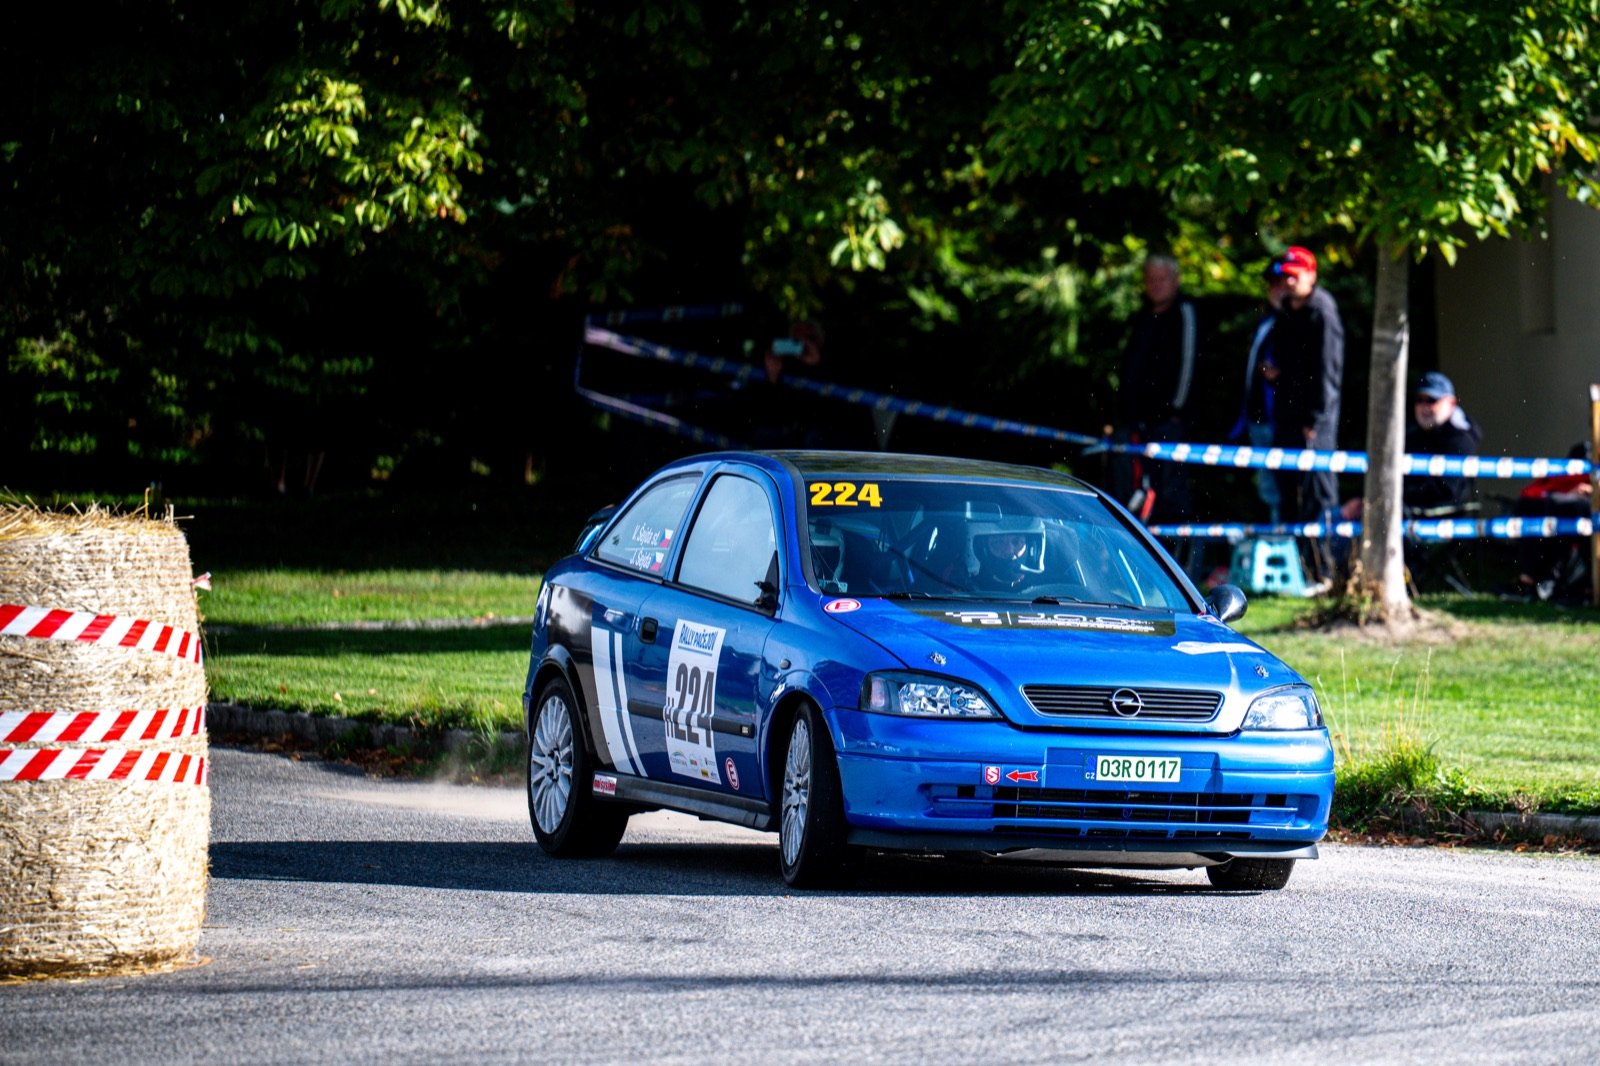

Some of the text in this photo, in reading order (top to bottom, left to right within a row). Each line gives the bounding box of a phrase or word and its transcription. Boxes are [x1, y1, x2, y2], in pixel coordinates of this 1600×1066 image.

[809, 482, 883, 507] 224
[678, 623, 696, 646] RALLY
[672, 662, 715, 749] 224
[1085, 758, 1179, 779] CZ 03R 0117
